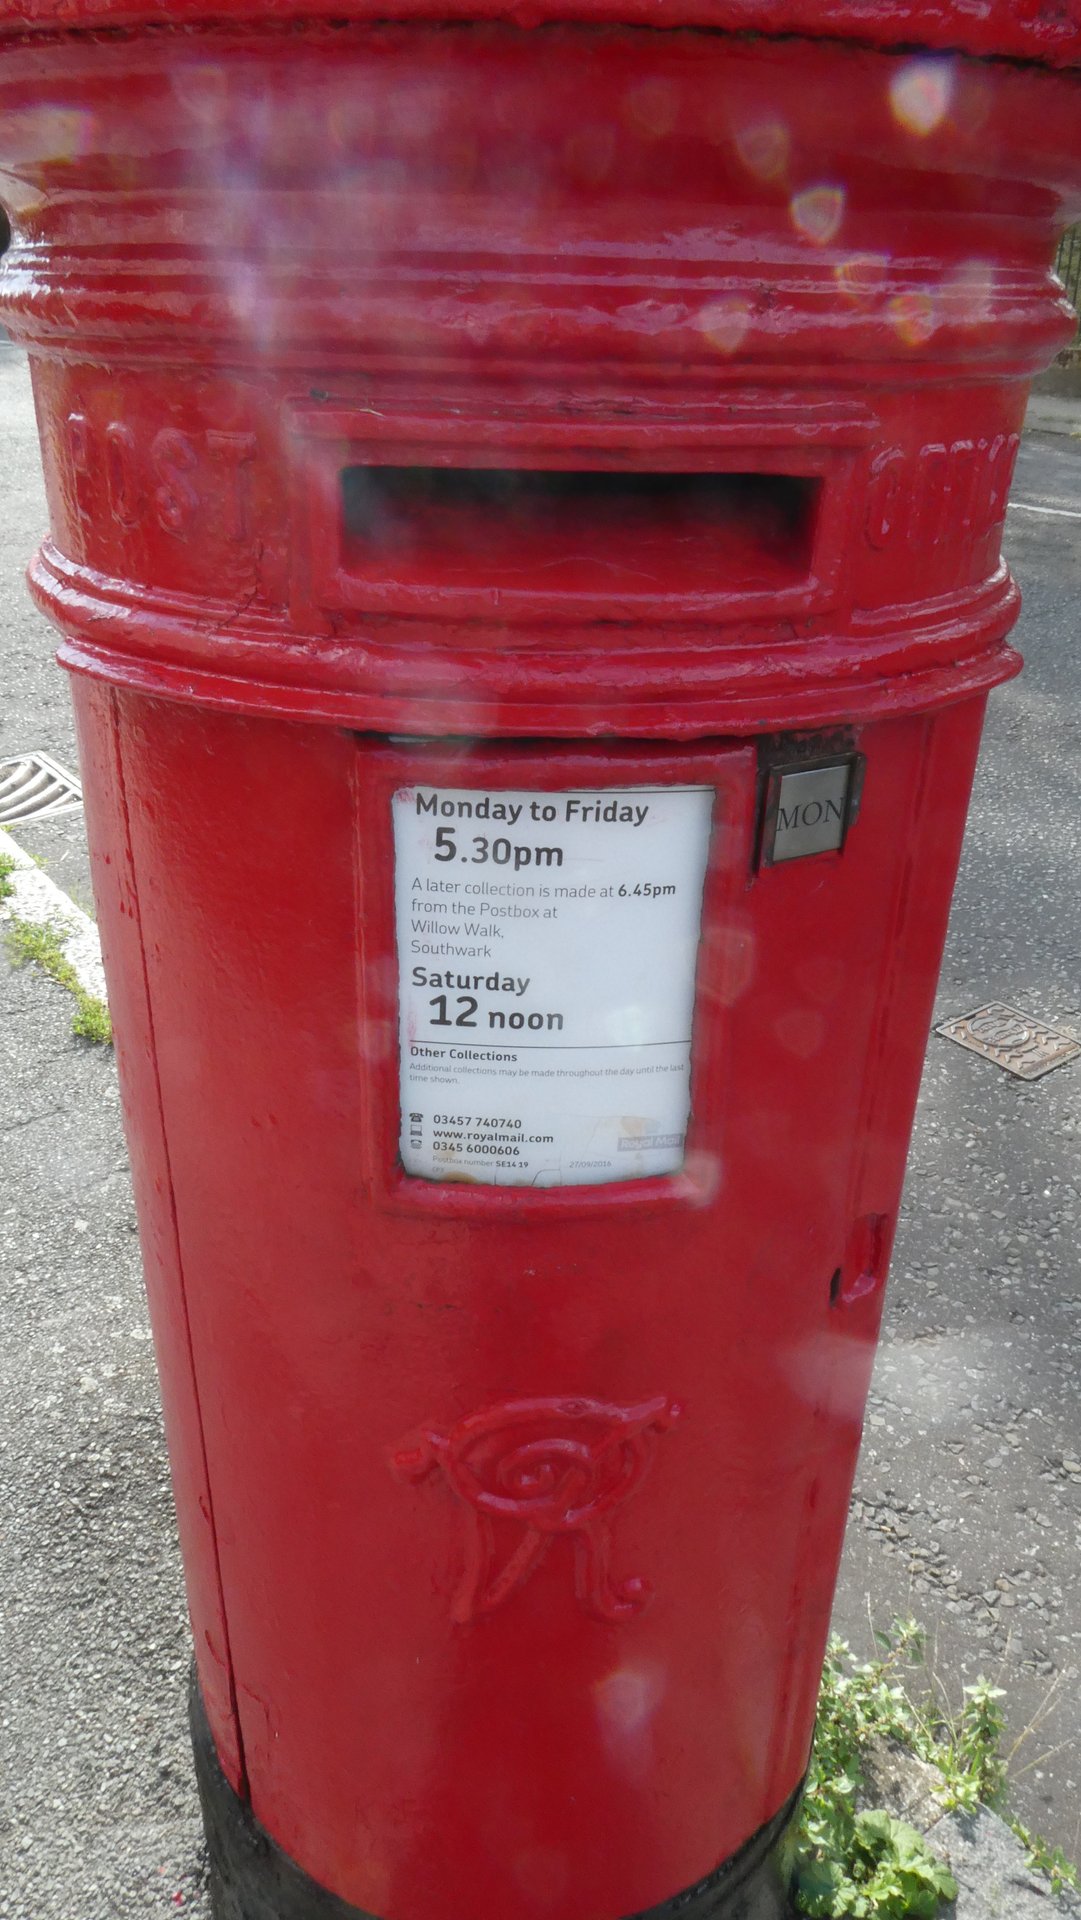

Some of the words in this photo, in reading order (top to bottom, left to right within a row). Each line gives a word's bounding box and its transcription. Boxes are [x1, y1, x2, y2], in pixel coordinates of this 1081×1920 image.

[416, 792, 523, 826] Monday
[529, 801, 557, 822] to
[565, 799, 649, 827] Friday
[776, 798, 844, 832] MON
[434, 826, 563, 872] 5.30pm
[411, 877, 423, 891] A
[426, 878, 461, 893] later
[464, 881, 535, 898] collection
[539, 884, 551, 898] is
[554, 884, 596, 898] made
[599, 885, 614, 898] at
[618, 882, 677, 899] 6.45pm
[411, 898, 448, 914] from
[452, 901, 476, 916] the
[480, 902, 540, 919] Postbox
[543, 906, 558, 919] at
[411, 919, 461, 935] Willow
[464, 922, 504, 939] Walk,
[411, 940, 492, 958] Southwark
[411, 966, 531, 997] Saturday
[429, 994, 479, 1028] 12
[488, 1011, 564, 1031] noon
[410, 1045, 446, 1058] Other
[449, 1048, 518, 1062] Collections
[409, 1062, 453, 1072] Additional
[453, 1065, 498, 1075] collections
[499, 1068, 517, 1077] may
[519, 1069, 530, 1077] be
[531, 1069, 556, 1077] made
[556, 1069, 604, 1078] throughout
[605, 1067, 620, 1076] the
[620, 1066, 635, 1076] day
[635, 1064, 655, 1075] until
[655, 1063, 670, 1073] the
[670, 1062, 684, 1072] last
[409, 1073, 429, 1082] time
[430, 1075, 459, 1085] shown.
[433, 1114, 472, 1126] 03457
[475, 1117, 522, 1130] 740740
[433, 1130, 554, 1144] www.royalmail.com
[623, 1137, 654, 1150] Royal
[655, 1136, 680, 1147] Mail
[432, 1141, 463, 1153] 0345
[466, 1144, 520, 1157] 6000606
[464, 1159, 494, 1167] number
[495, 1160, 517, 1169] SE14
[569, 1159, 612, 1169] 27/09/2016
